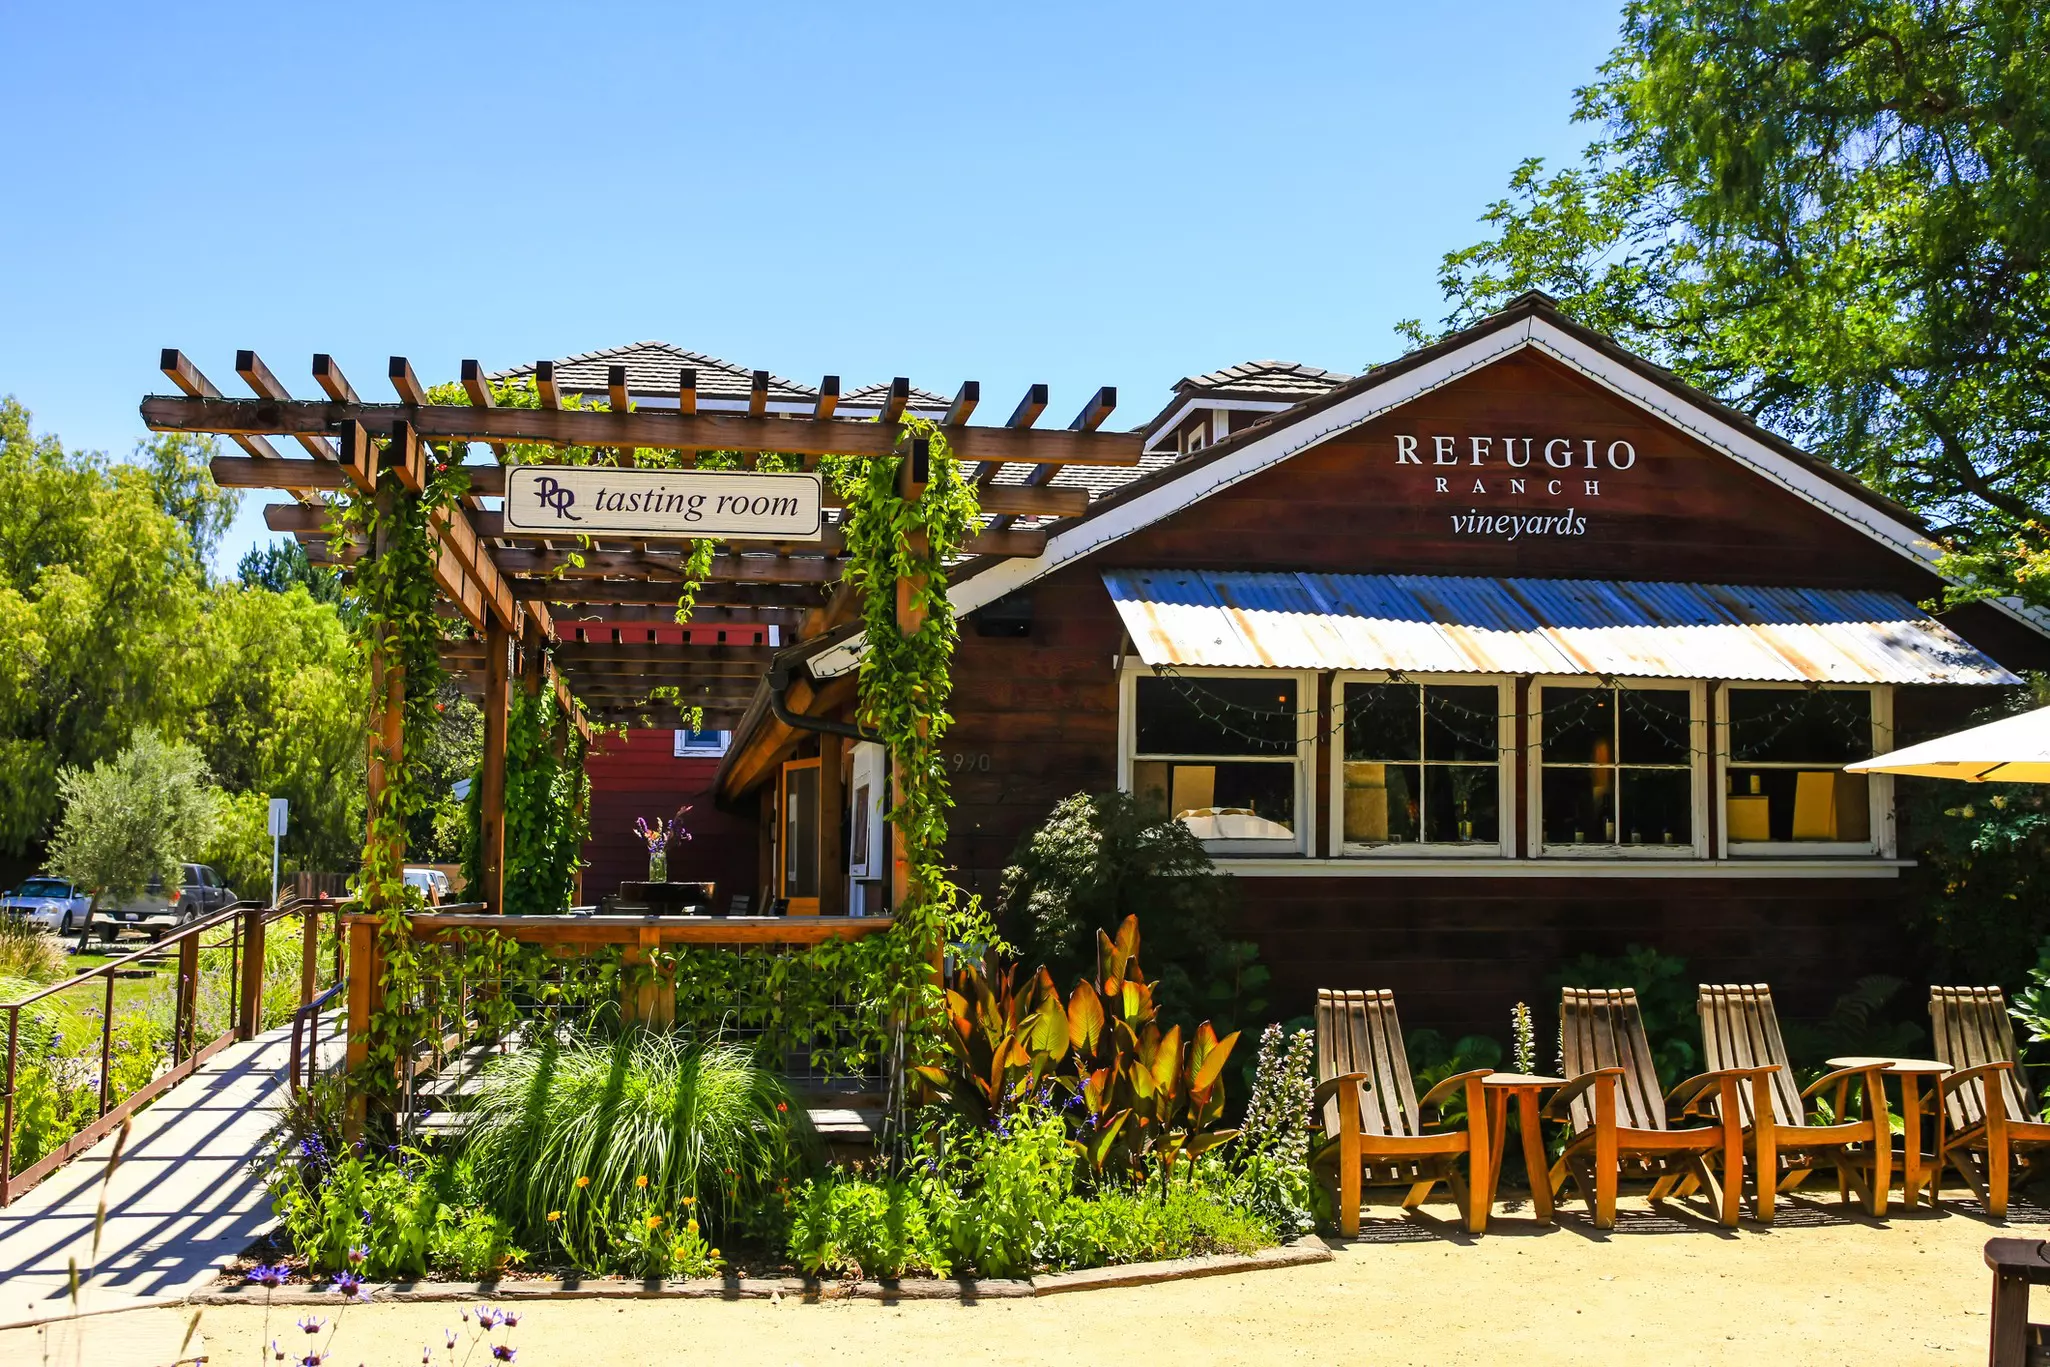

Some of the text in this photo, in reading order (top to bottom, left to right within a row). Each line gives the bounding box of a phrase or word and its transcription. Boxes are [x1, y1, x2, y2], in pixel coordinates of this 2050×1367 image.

[1394, 434, 1636, 470] REFUGIO
[595, 486, 707, 522] tasting
[716, 494, 799, 517] room
[1435, 477, 1600, 496] RANCH
[1450, 507, 1587, 542] vineyards
